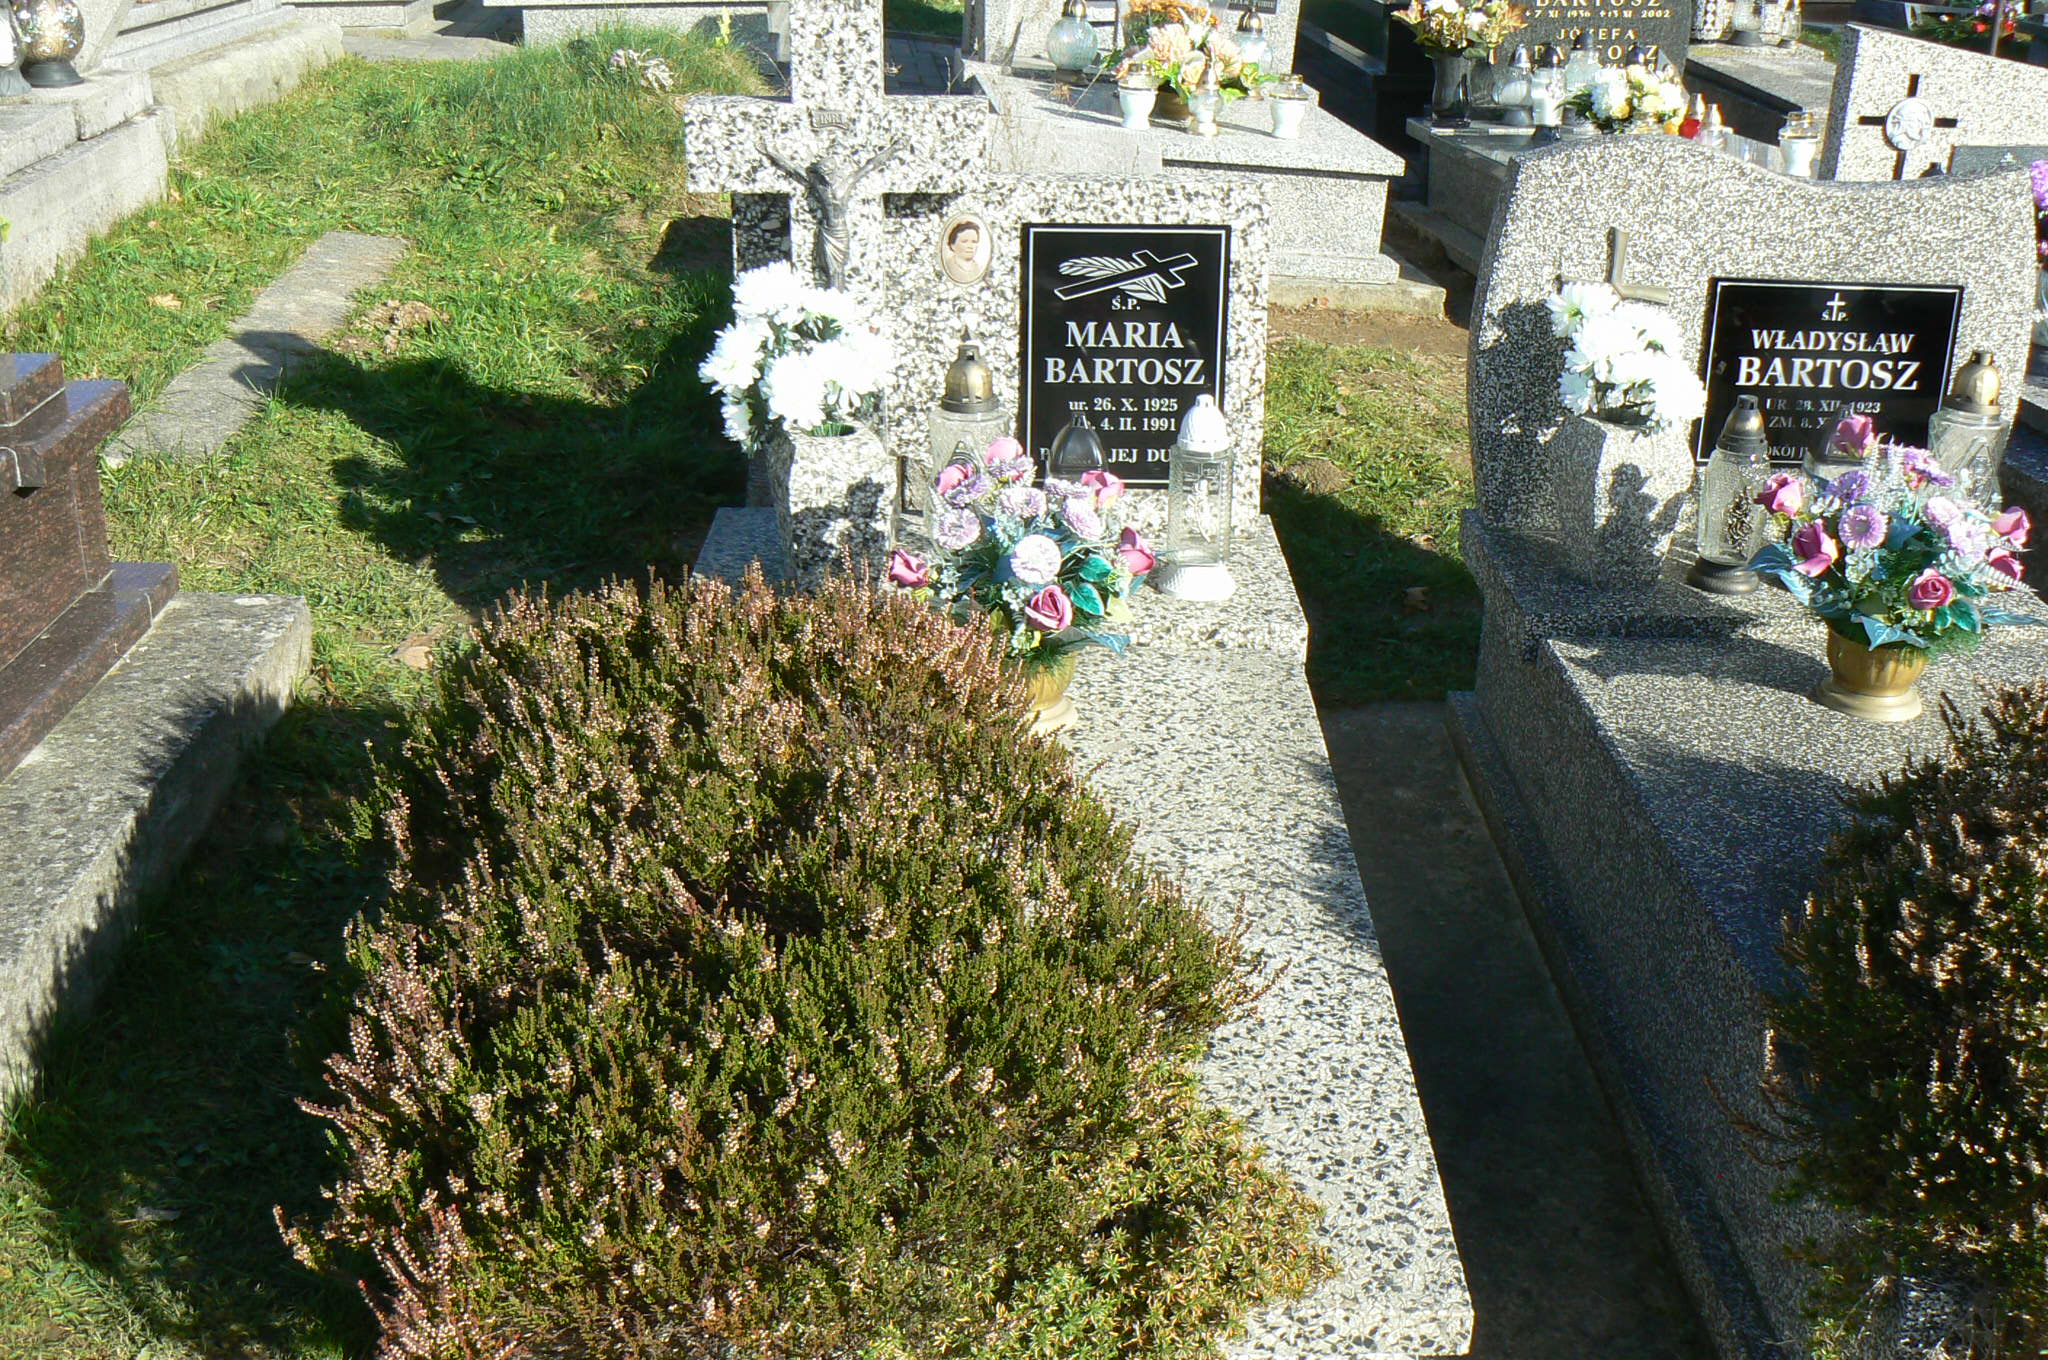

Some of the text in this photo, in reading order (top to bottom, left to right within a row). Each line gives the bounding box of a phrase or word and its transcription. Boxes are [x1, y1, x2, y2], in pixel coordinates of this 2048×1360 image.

[1640, 9, 1671, 18] 2002
[1556, 26, 1638, 40] JÓEFA
[1065, 321, 1184, 348] MARIA
[1751, 329, 1915, 354] WŁADYSŁAW
[1044, 357, 1205, 385] BARTOSZ
[1735, 356, 1921, 391] BARTOSZ
[1068, 397, 1178, 411] ur. 26. X. 1925
[1100, 417, 1114, 430] 4.
[1119, 418, 1137, 430] II.
[1142, 418, 1177, 431] 1991
[1108, 448, 1138, 463] JEJ
